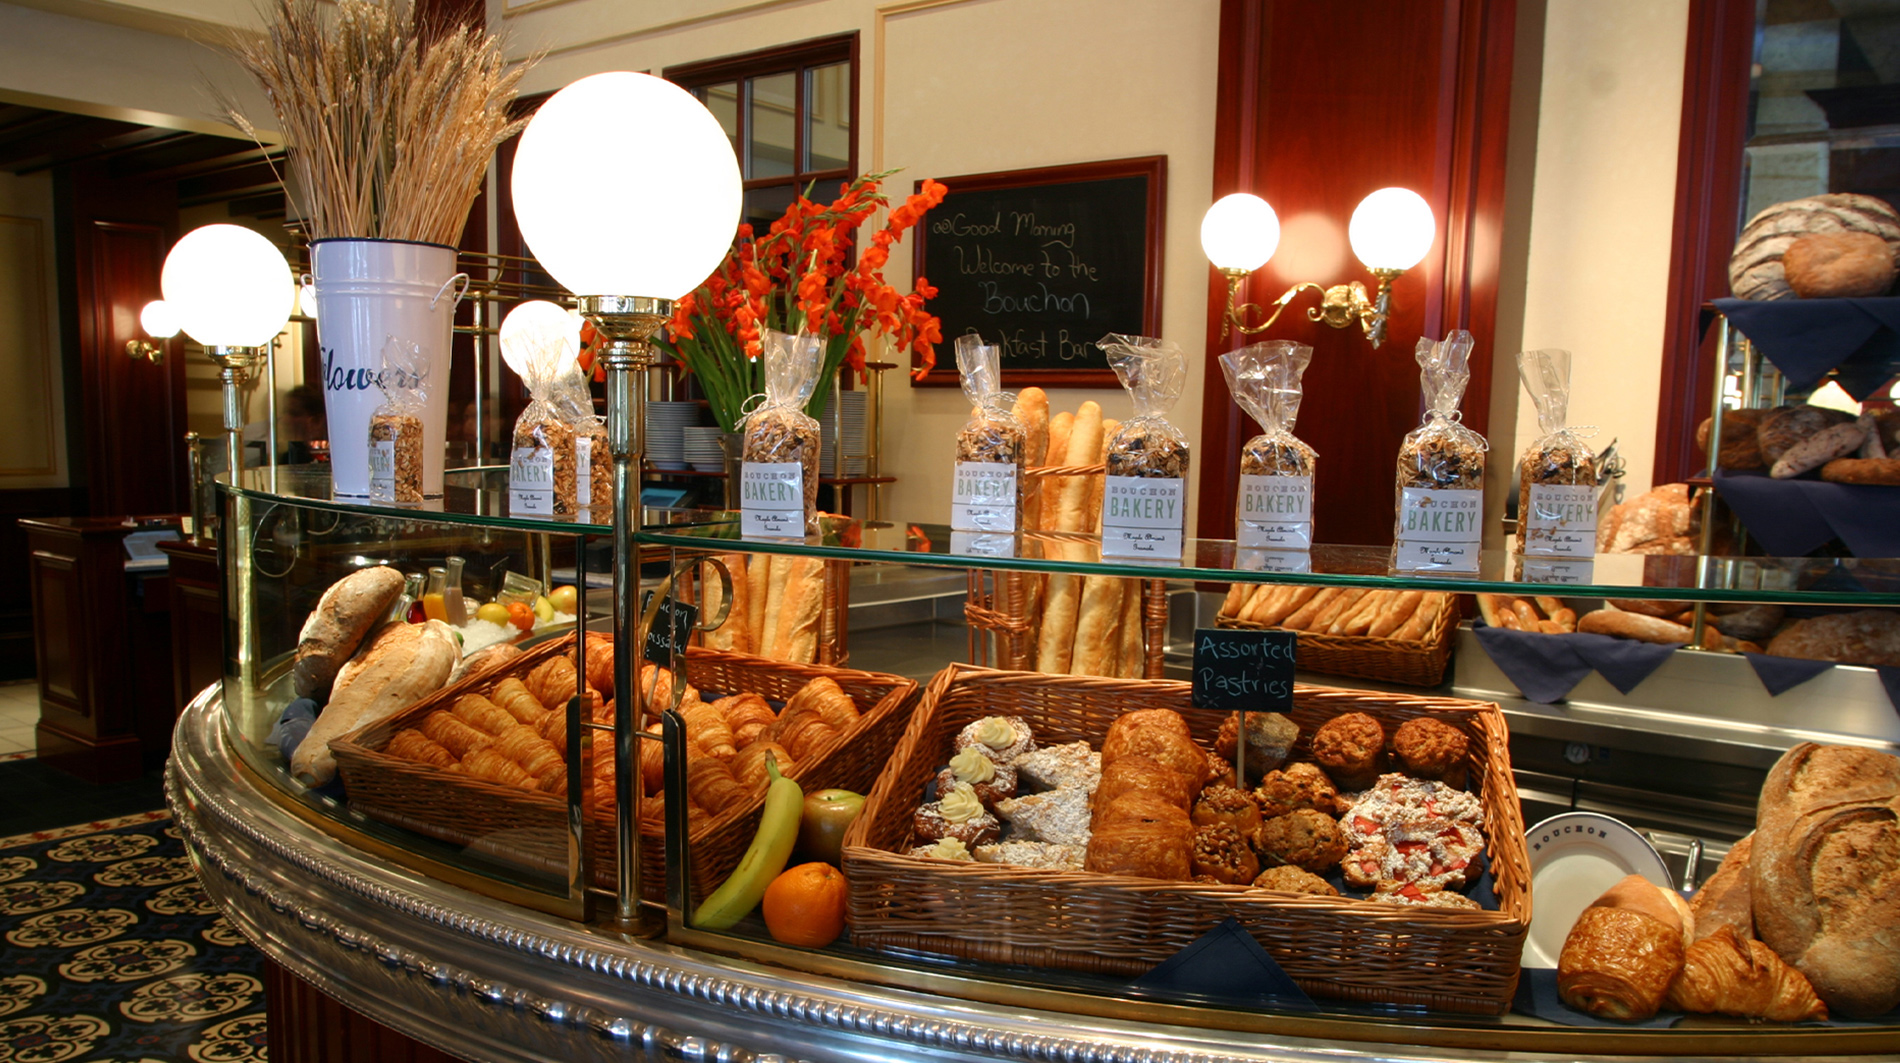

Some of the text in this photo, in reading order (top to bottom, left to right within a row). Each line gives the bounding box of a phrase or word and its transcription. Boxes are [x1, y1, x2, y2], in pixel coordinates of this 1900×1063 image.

[952, 212, 1001, 236] Good
[954, 245, 1099, 282] Welcome to the
[978, 281, 1090, 320] Bouchon
[966, 327, 1094, 360] kfast Bar
[744, 481, 796, 501] BAKERY
[957, 478, 1011, 497] BAKERY
[1111, 486, 1176, 496] BOUCHON
[1246, 484, 1306, 493] BOUCHON
[1536, 493, 1593, 501] BOUCHON
[1110, 496, 1176, 519] BAKERY
[1245, 494, 1305, 513] BAKERY
[1409, 499, 1477, 509] UCHON
[1535, 502, 1593, 522] BAKERY
[1407, 509, 1476, 533] BAKERY
[1199, 635, 1296, 663] Assorted
[1198, 667, 1288, 699] Pastries
[1533, 825, 1608, 851] BOUCHON
